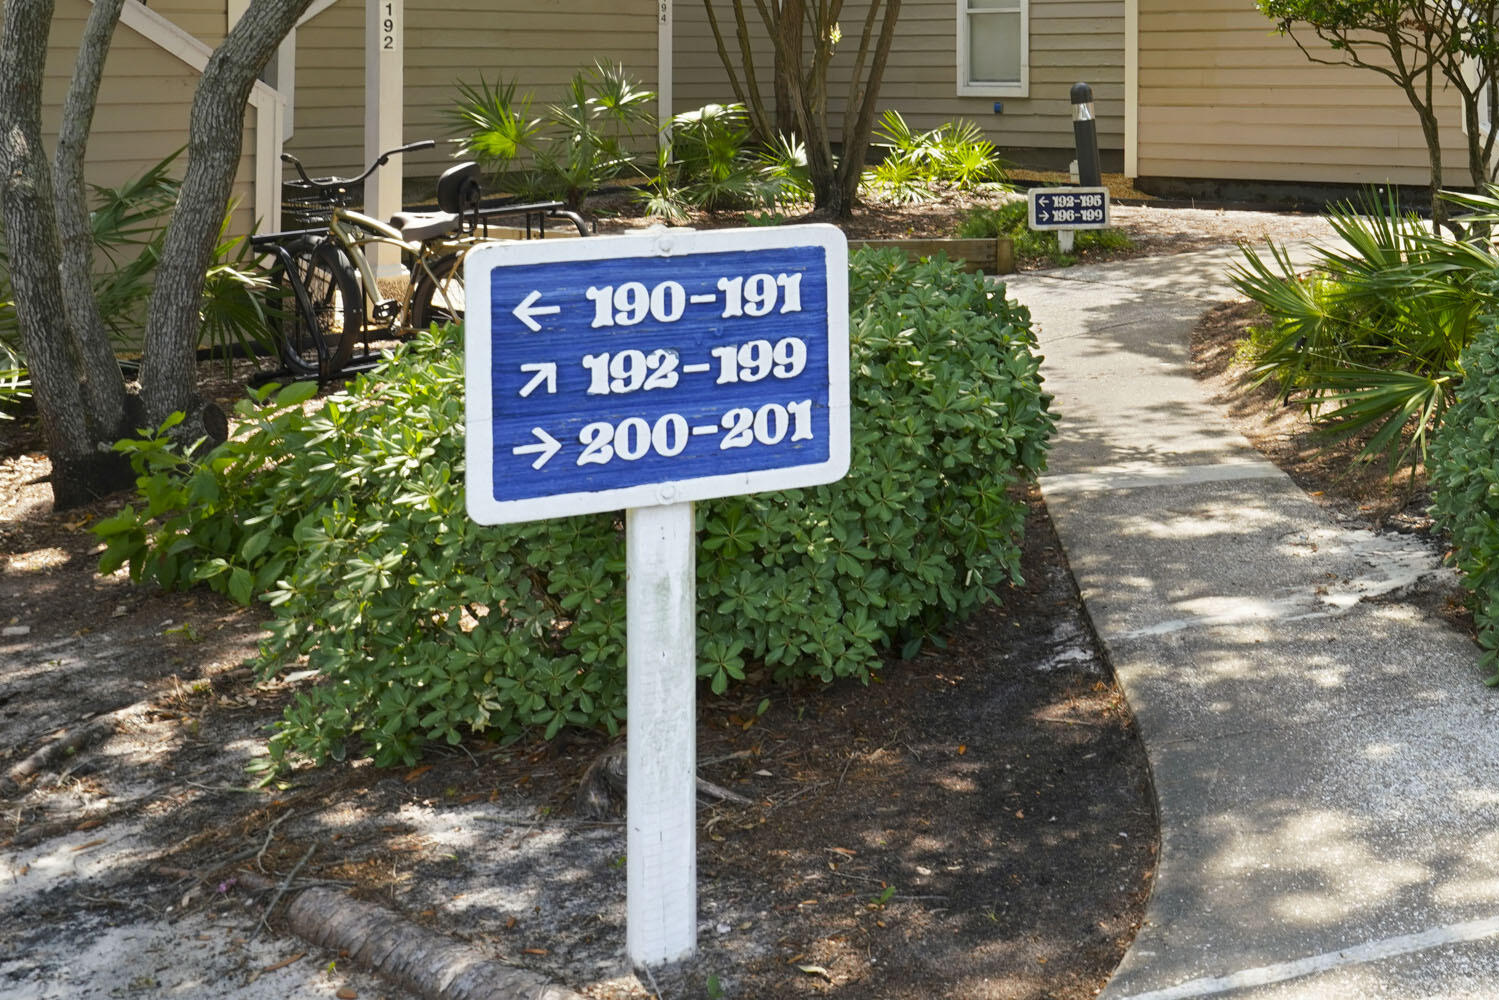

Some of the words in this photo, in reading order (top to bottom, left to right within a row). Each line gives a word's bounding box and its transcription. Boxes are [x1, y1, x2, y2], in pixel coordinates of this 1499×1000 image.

[383, 2, 394, 49] 192
[1052, 195, 1102, 208] 192-195
[1052, 209, 1103, 222] 196-199
[585, 272, 803, 329] 190-191
[582, 337, 807, 396] 192-199
[576, 399, 814, 467] 200-201
